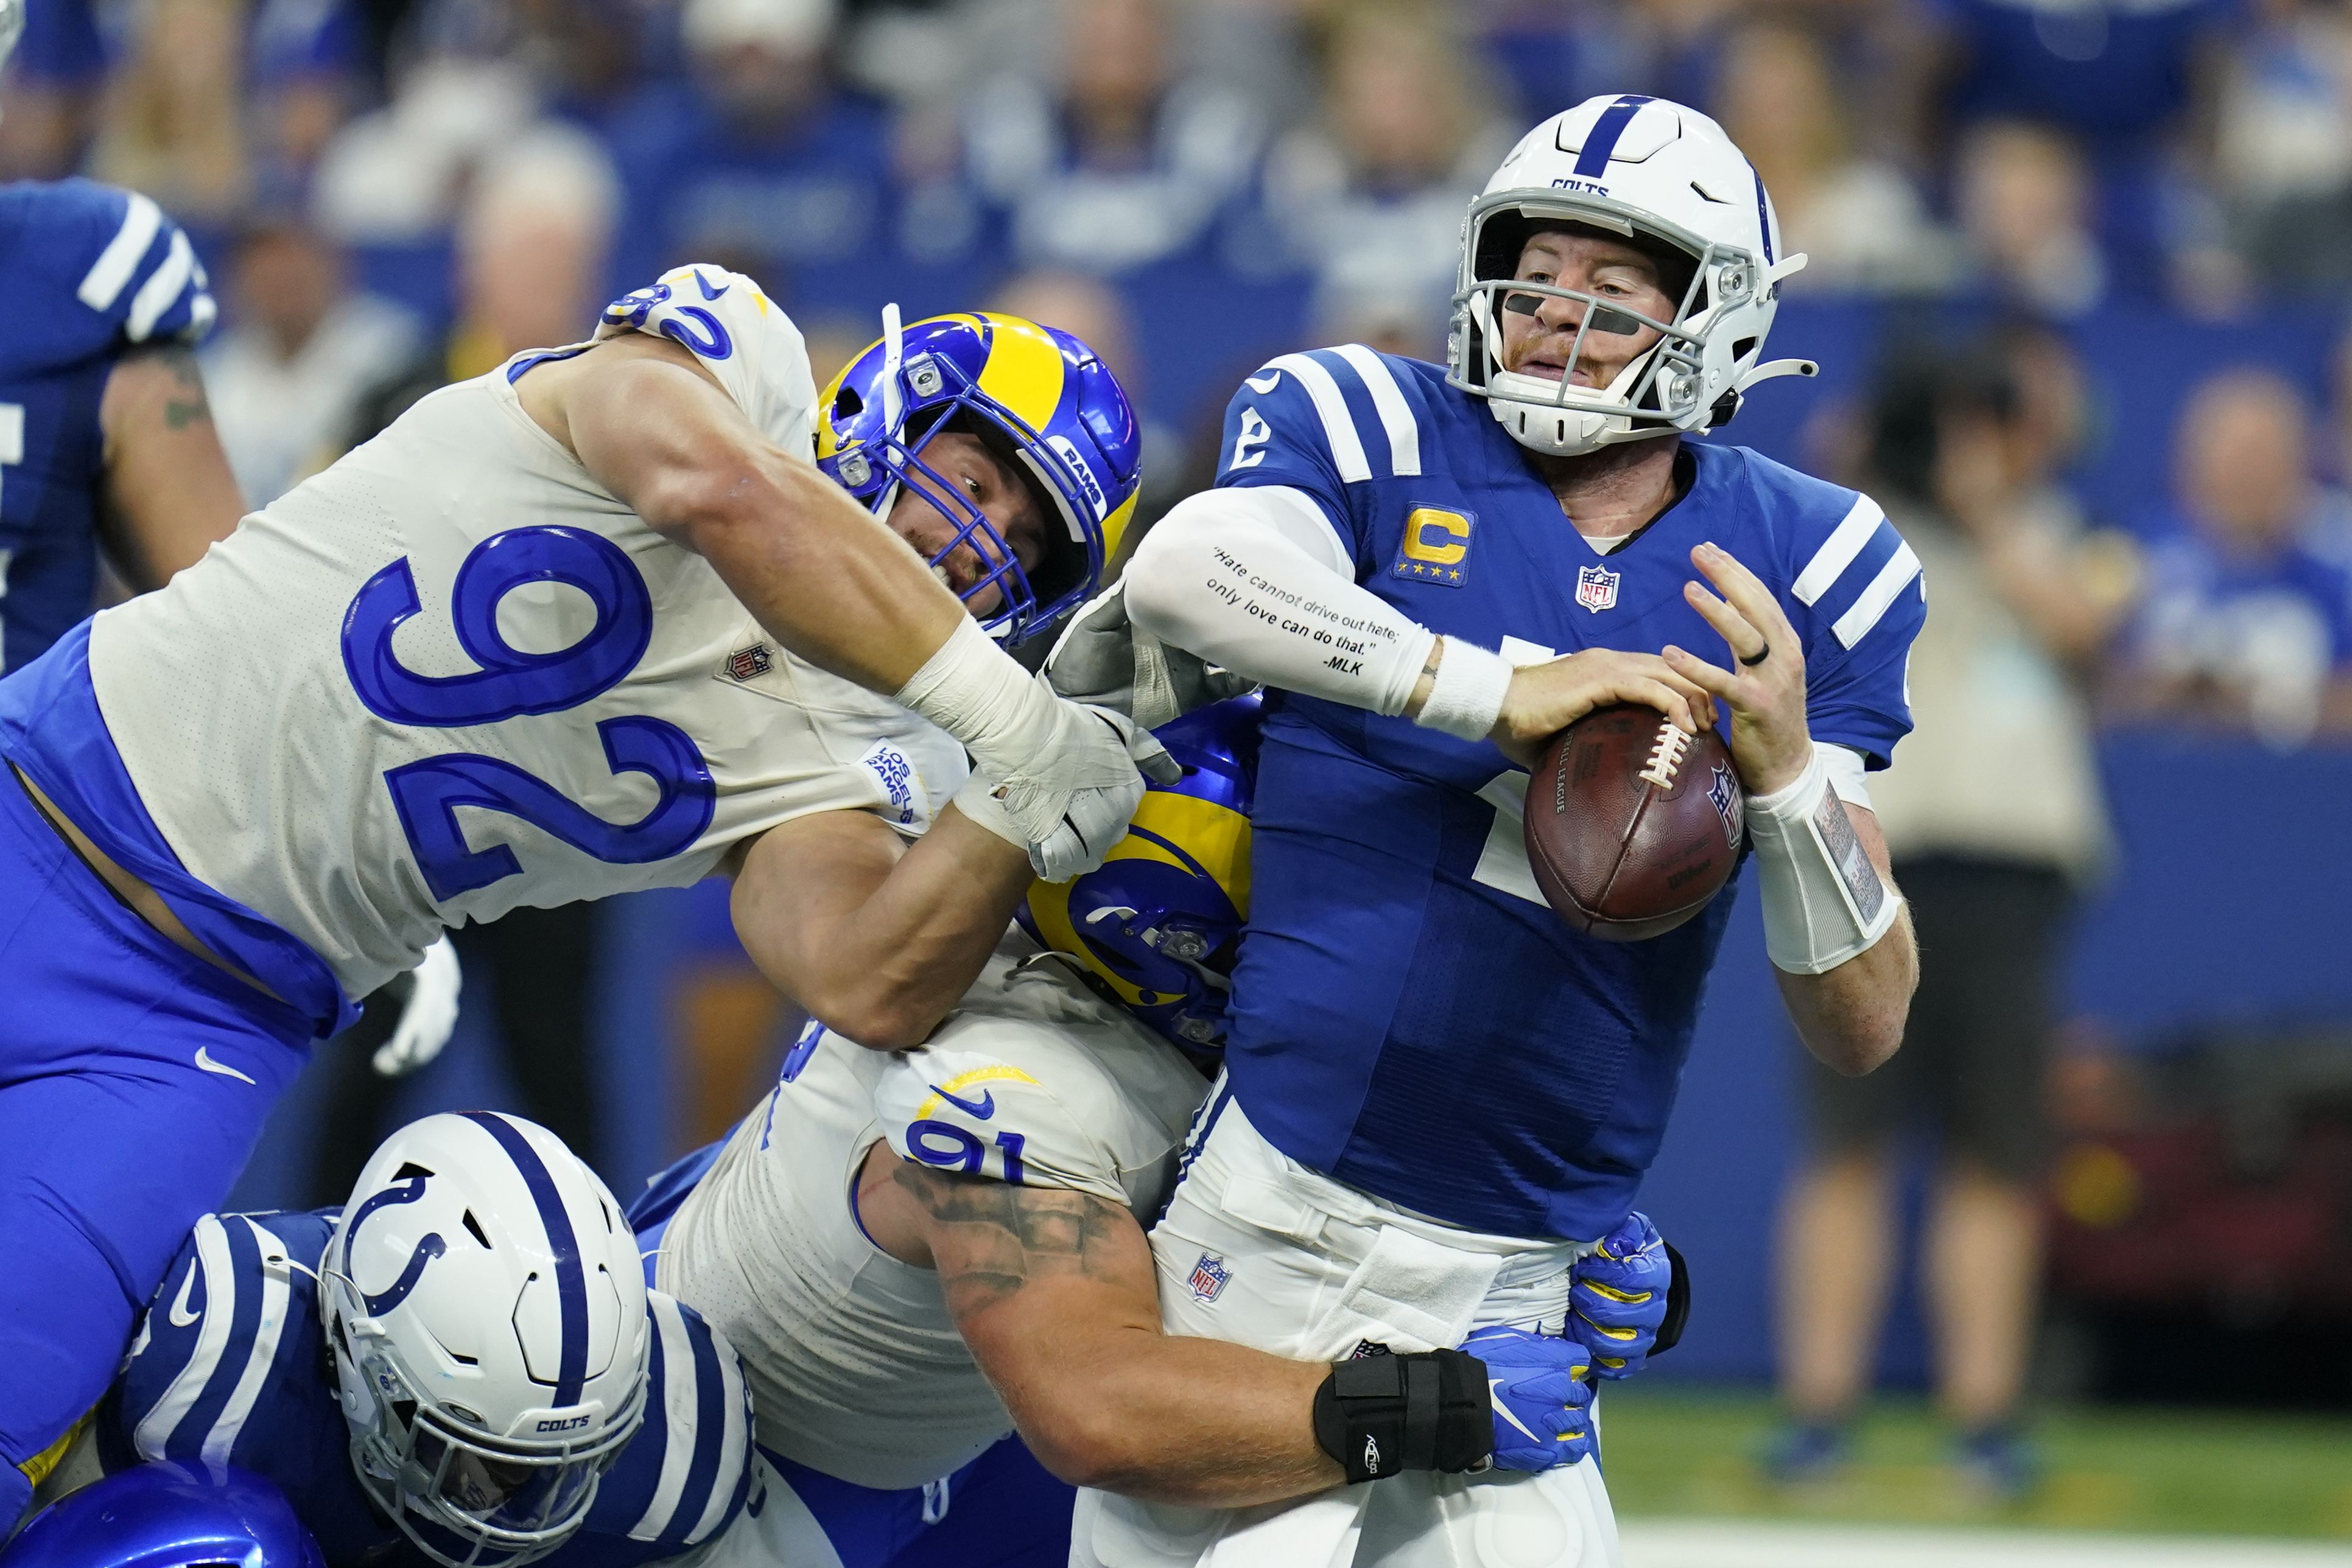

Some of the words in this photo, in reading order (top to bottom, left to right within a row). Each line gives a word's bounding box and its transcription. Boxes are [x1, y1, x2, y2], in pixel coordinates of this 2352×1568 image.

[1551, 178, 1609, 197] COLTS
[1229, 407, 1272, 471] 2
[1064, 447, 1102, 505] RAMS
[1403, 508, 1470, 564] C
[1207, 578, 1242, 606] only
[1244, 599, 1277, 625] love
[1282, 618, 1310, 637] can
[1313, 629, 1332, 644] do
[1250, 575, 1303, 607] cannot
[1304, 599, 1339, 623] drive
[1342, 615, 1365, 631] out
[1367, 620, 1400, 643] hate;
[1583, 584, 1609, 604] NFL
[734, 652, 755, 677] NFL
[1323, 656, 1364, 676] -MLK
[340, 524, 717, 903] 92
[879, 747, 911, 779] LOS
[1556, 768, 1567, 814] LEAGUE
[906, 1119, 1025, 1186] 91
[1192, 1269, 1216, 1296] NFL
[536, 1415, 591, 1433] COLTS
